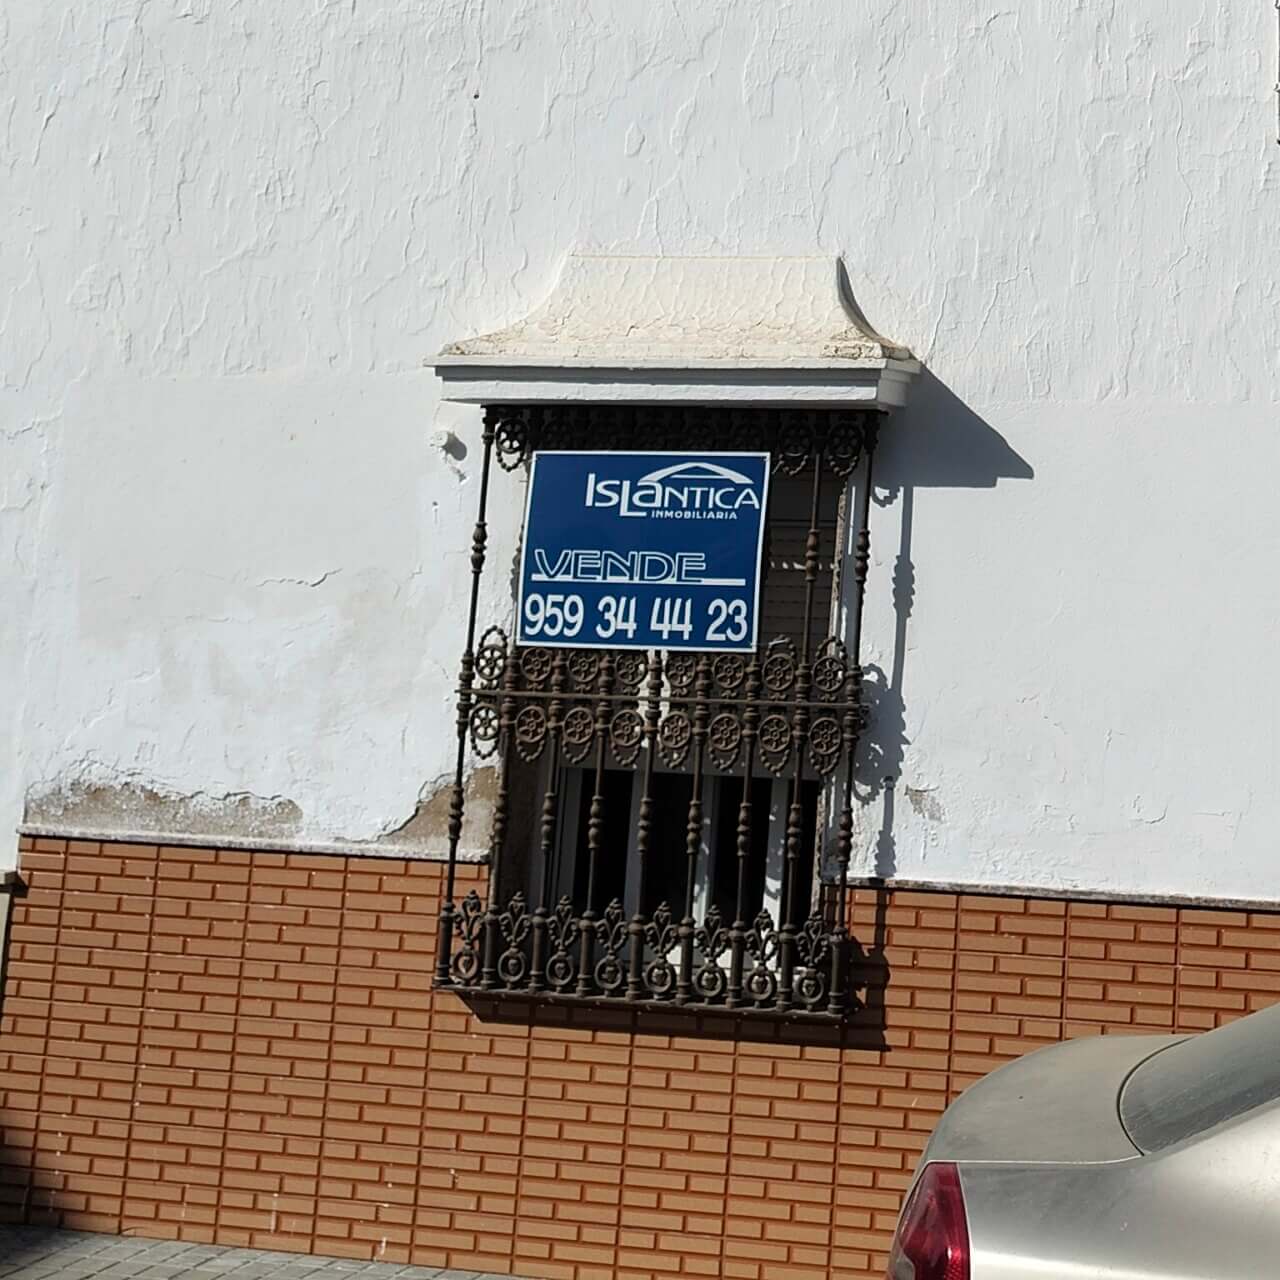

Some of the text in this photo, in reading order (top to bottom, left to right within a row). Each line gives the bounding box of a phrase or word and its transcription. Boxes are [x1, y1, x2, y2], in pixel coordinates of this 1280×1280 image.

[651, 509, 738, 520] INMOBILIARIA
[534, 548, 707, 583] VENDE
[524, 592, 748, 642] 959 34 44 23
